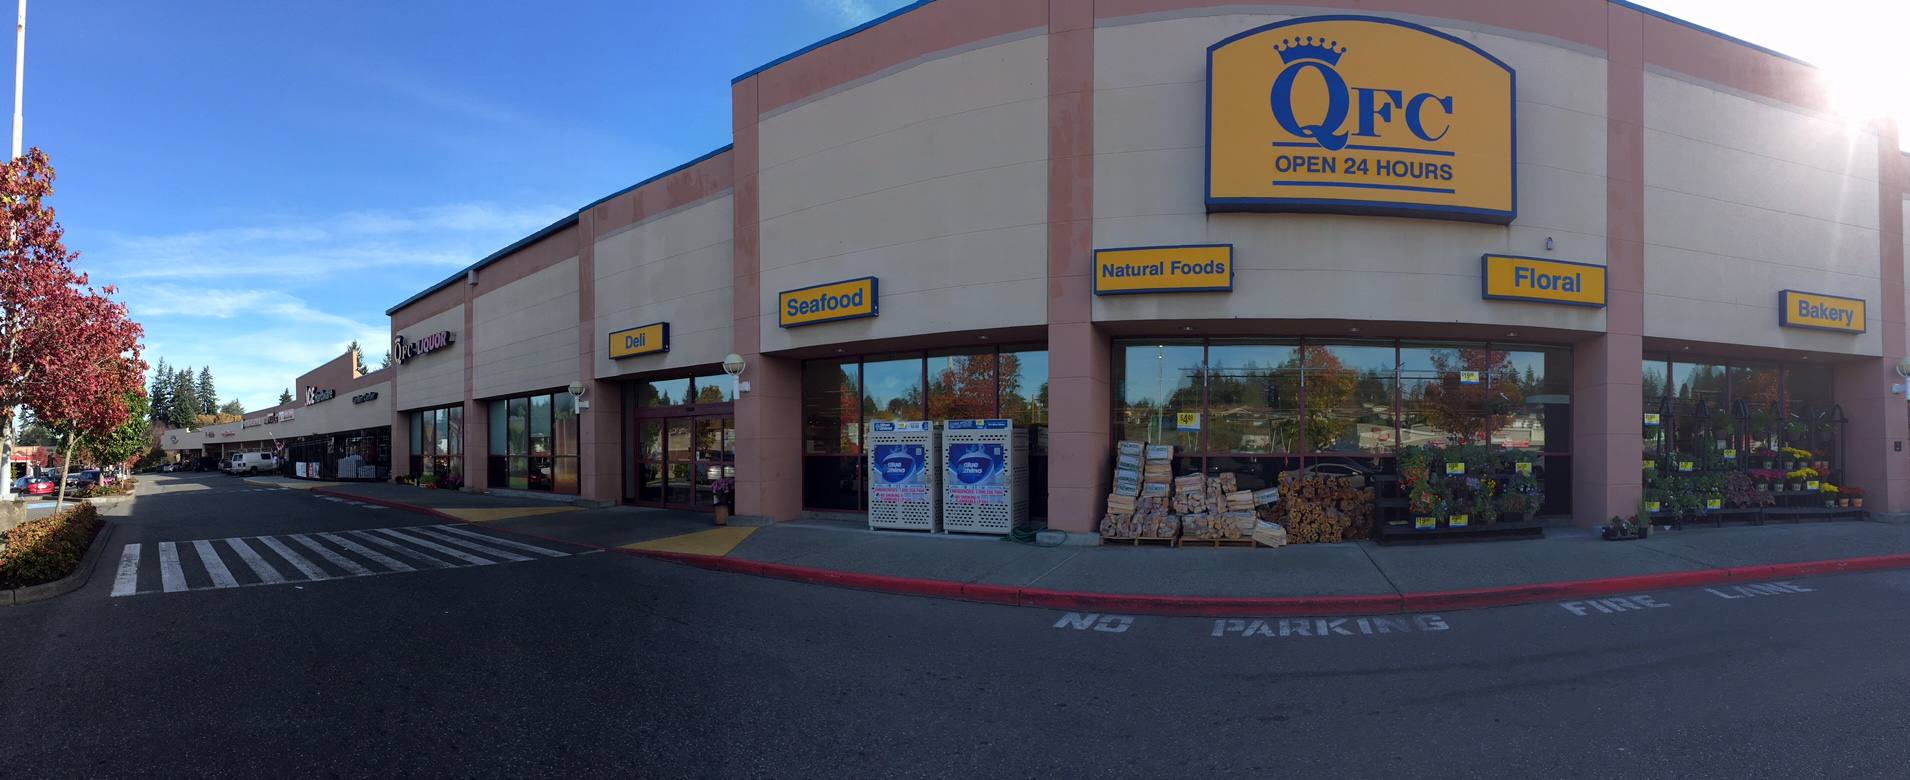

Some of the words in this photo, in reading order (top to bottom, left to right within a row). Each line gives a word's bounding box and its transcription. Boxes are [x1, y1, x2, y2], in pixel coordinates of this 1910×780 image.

[1271, 62, 1453, 150] QFC
[1275, 155, 1336, 174] OPEN
[1344, 157, 1369, 176] 24
[1376, 160, 1453, 180] HOURS
[1102, 260, 1164, 278] Natural
[1170, 258, 1225, 276] Foods
[1514, 266, 1581, 293] Floral
[786, 288, 864, 317] Seafood
[1798, 300, 1854, 326] Bakery
[394, 340, 413, 365] QFC
[416, 331, 447, 355] LIQUOR
[625, 332, 646, 349] Deli
[1559, 594, 1671, 616] FIRE
[1705, 581, 1817, 599] LANE
[1052, 612, 1135, 633] NO
[1211, 614, 1450, 637] PARKING
